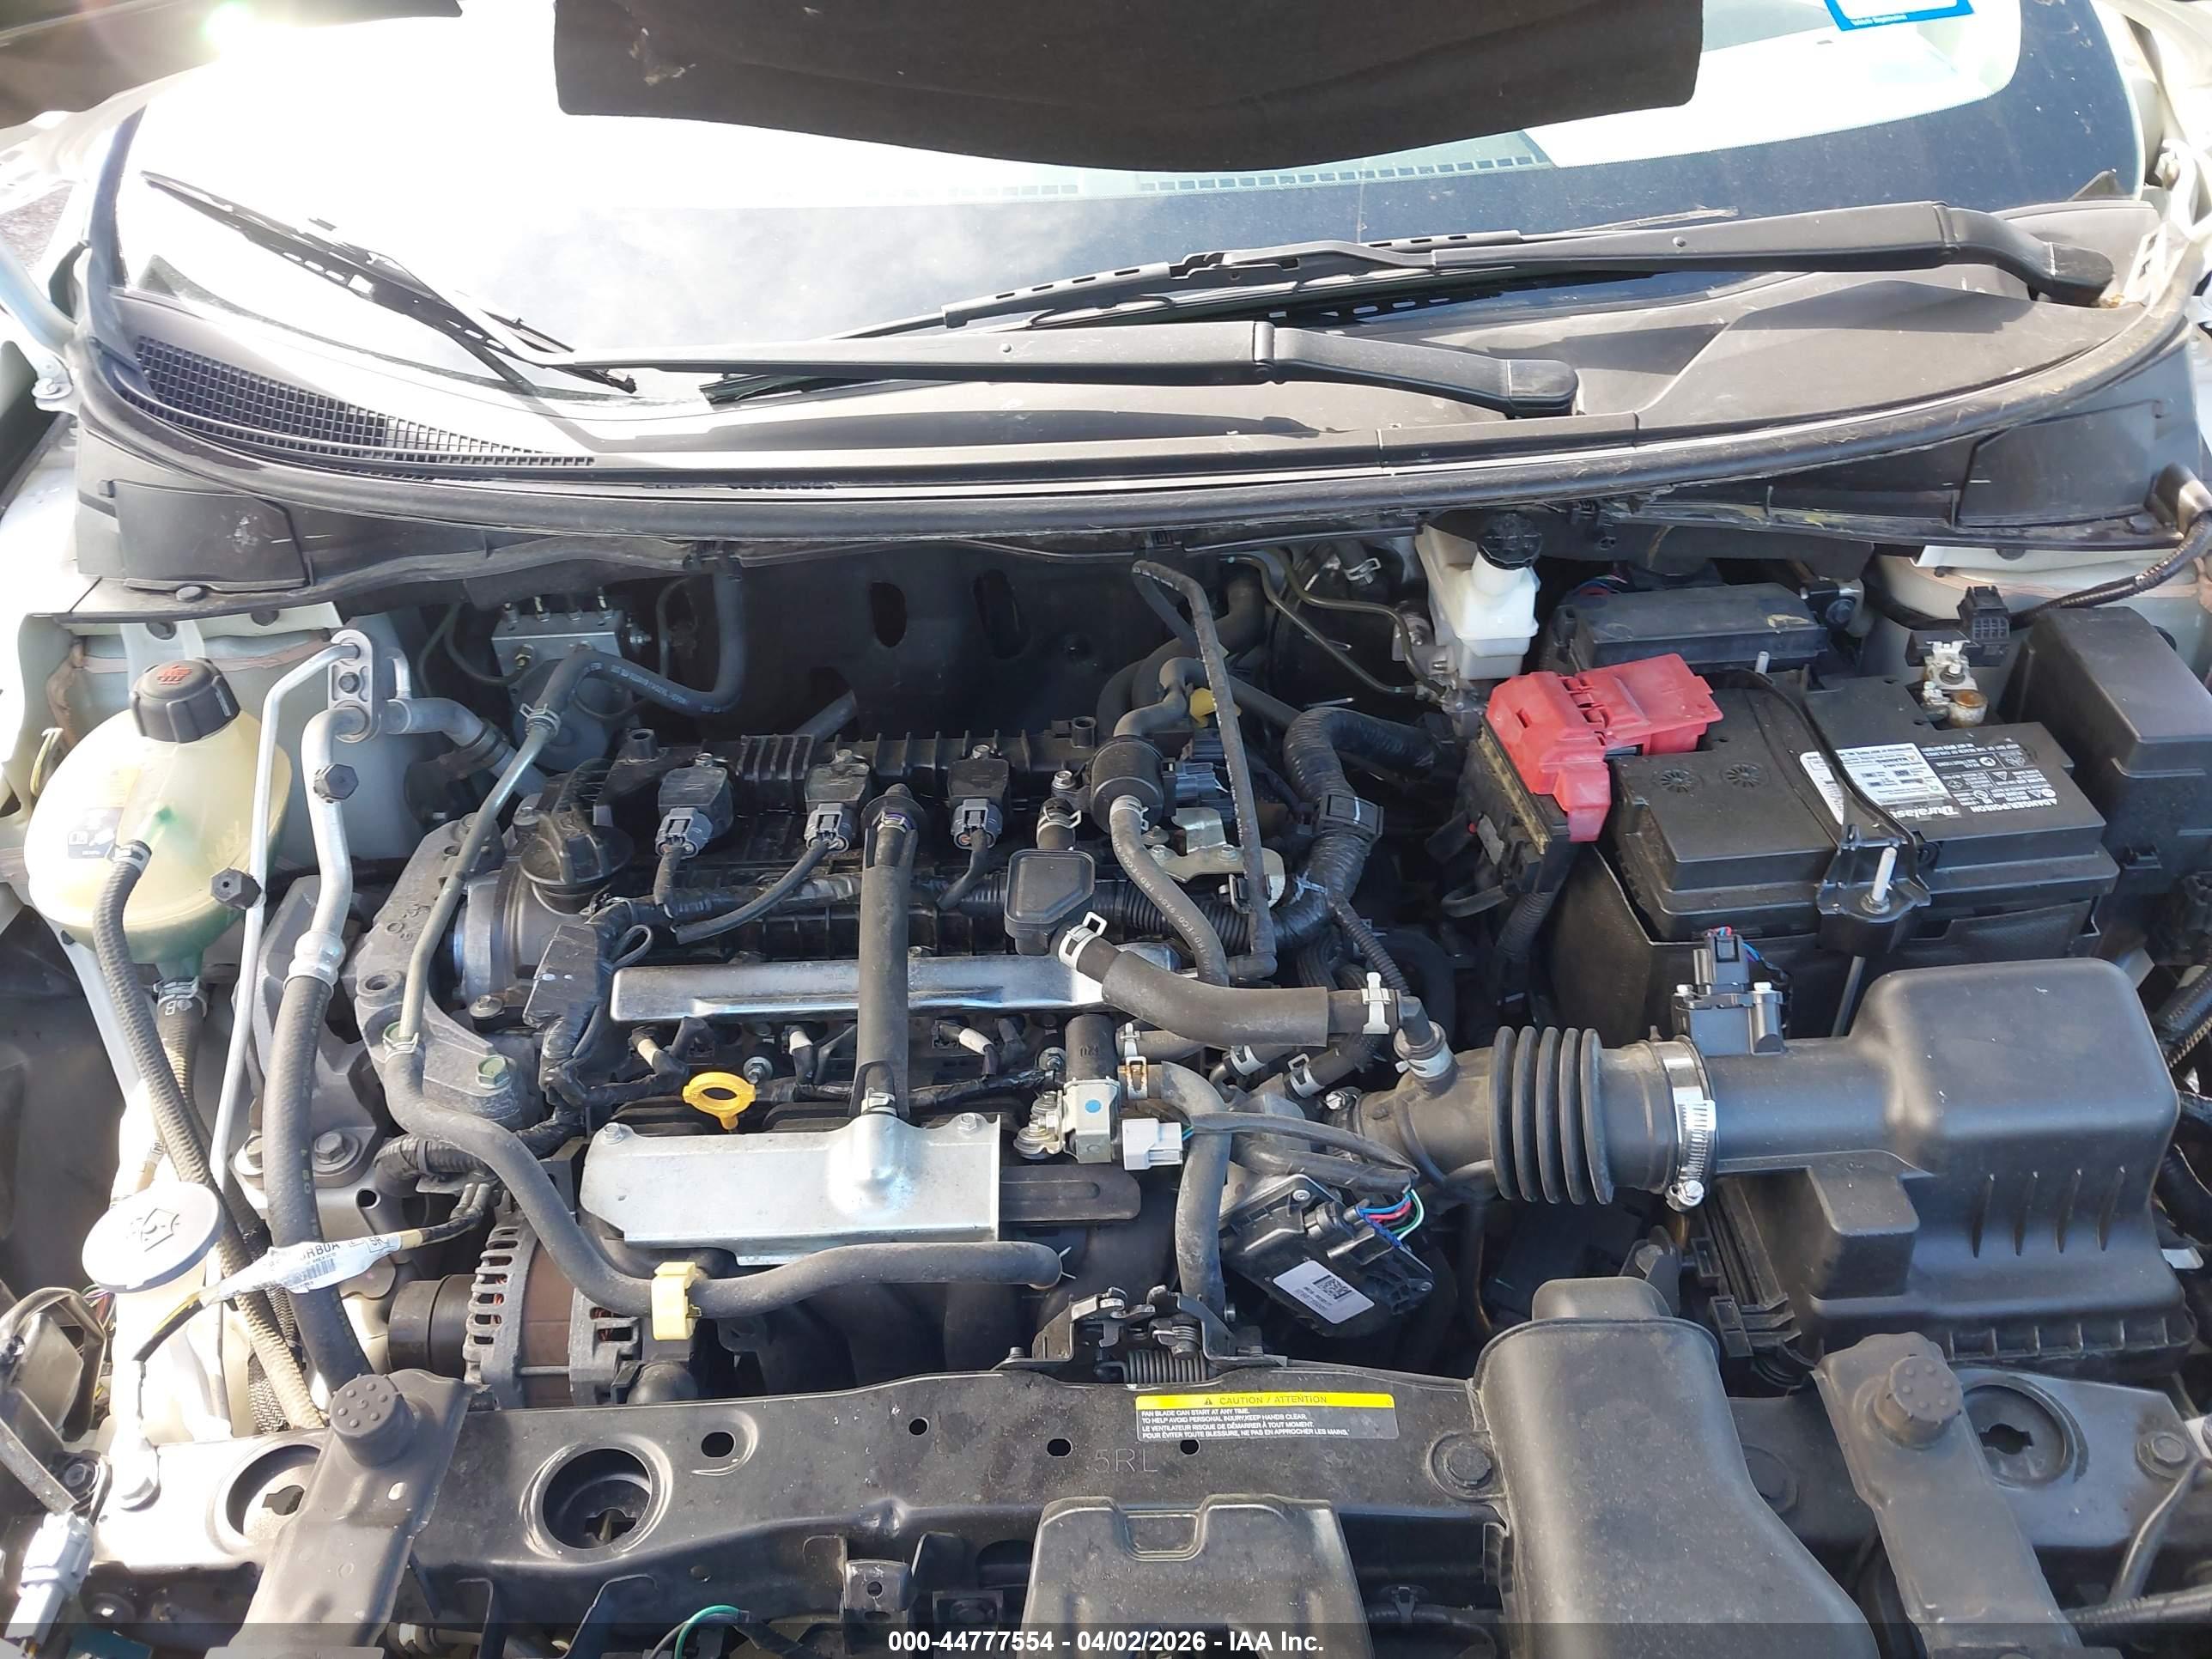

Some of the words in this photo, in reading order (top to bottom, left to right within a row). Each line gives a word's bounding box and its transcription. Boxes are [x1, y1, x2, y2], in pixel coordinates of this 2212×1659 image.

[1888, 805, 1959, 818] Duralast
[1219, 1396, 1263, 1406] CAUTION
[1094, 1448, 1158, 1473] 5RL
